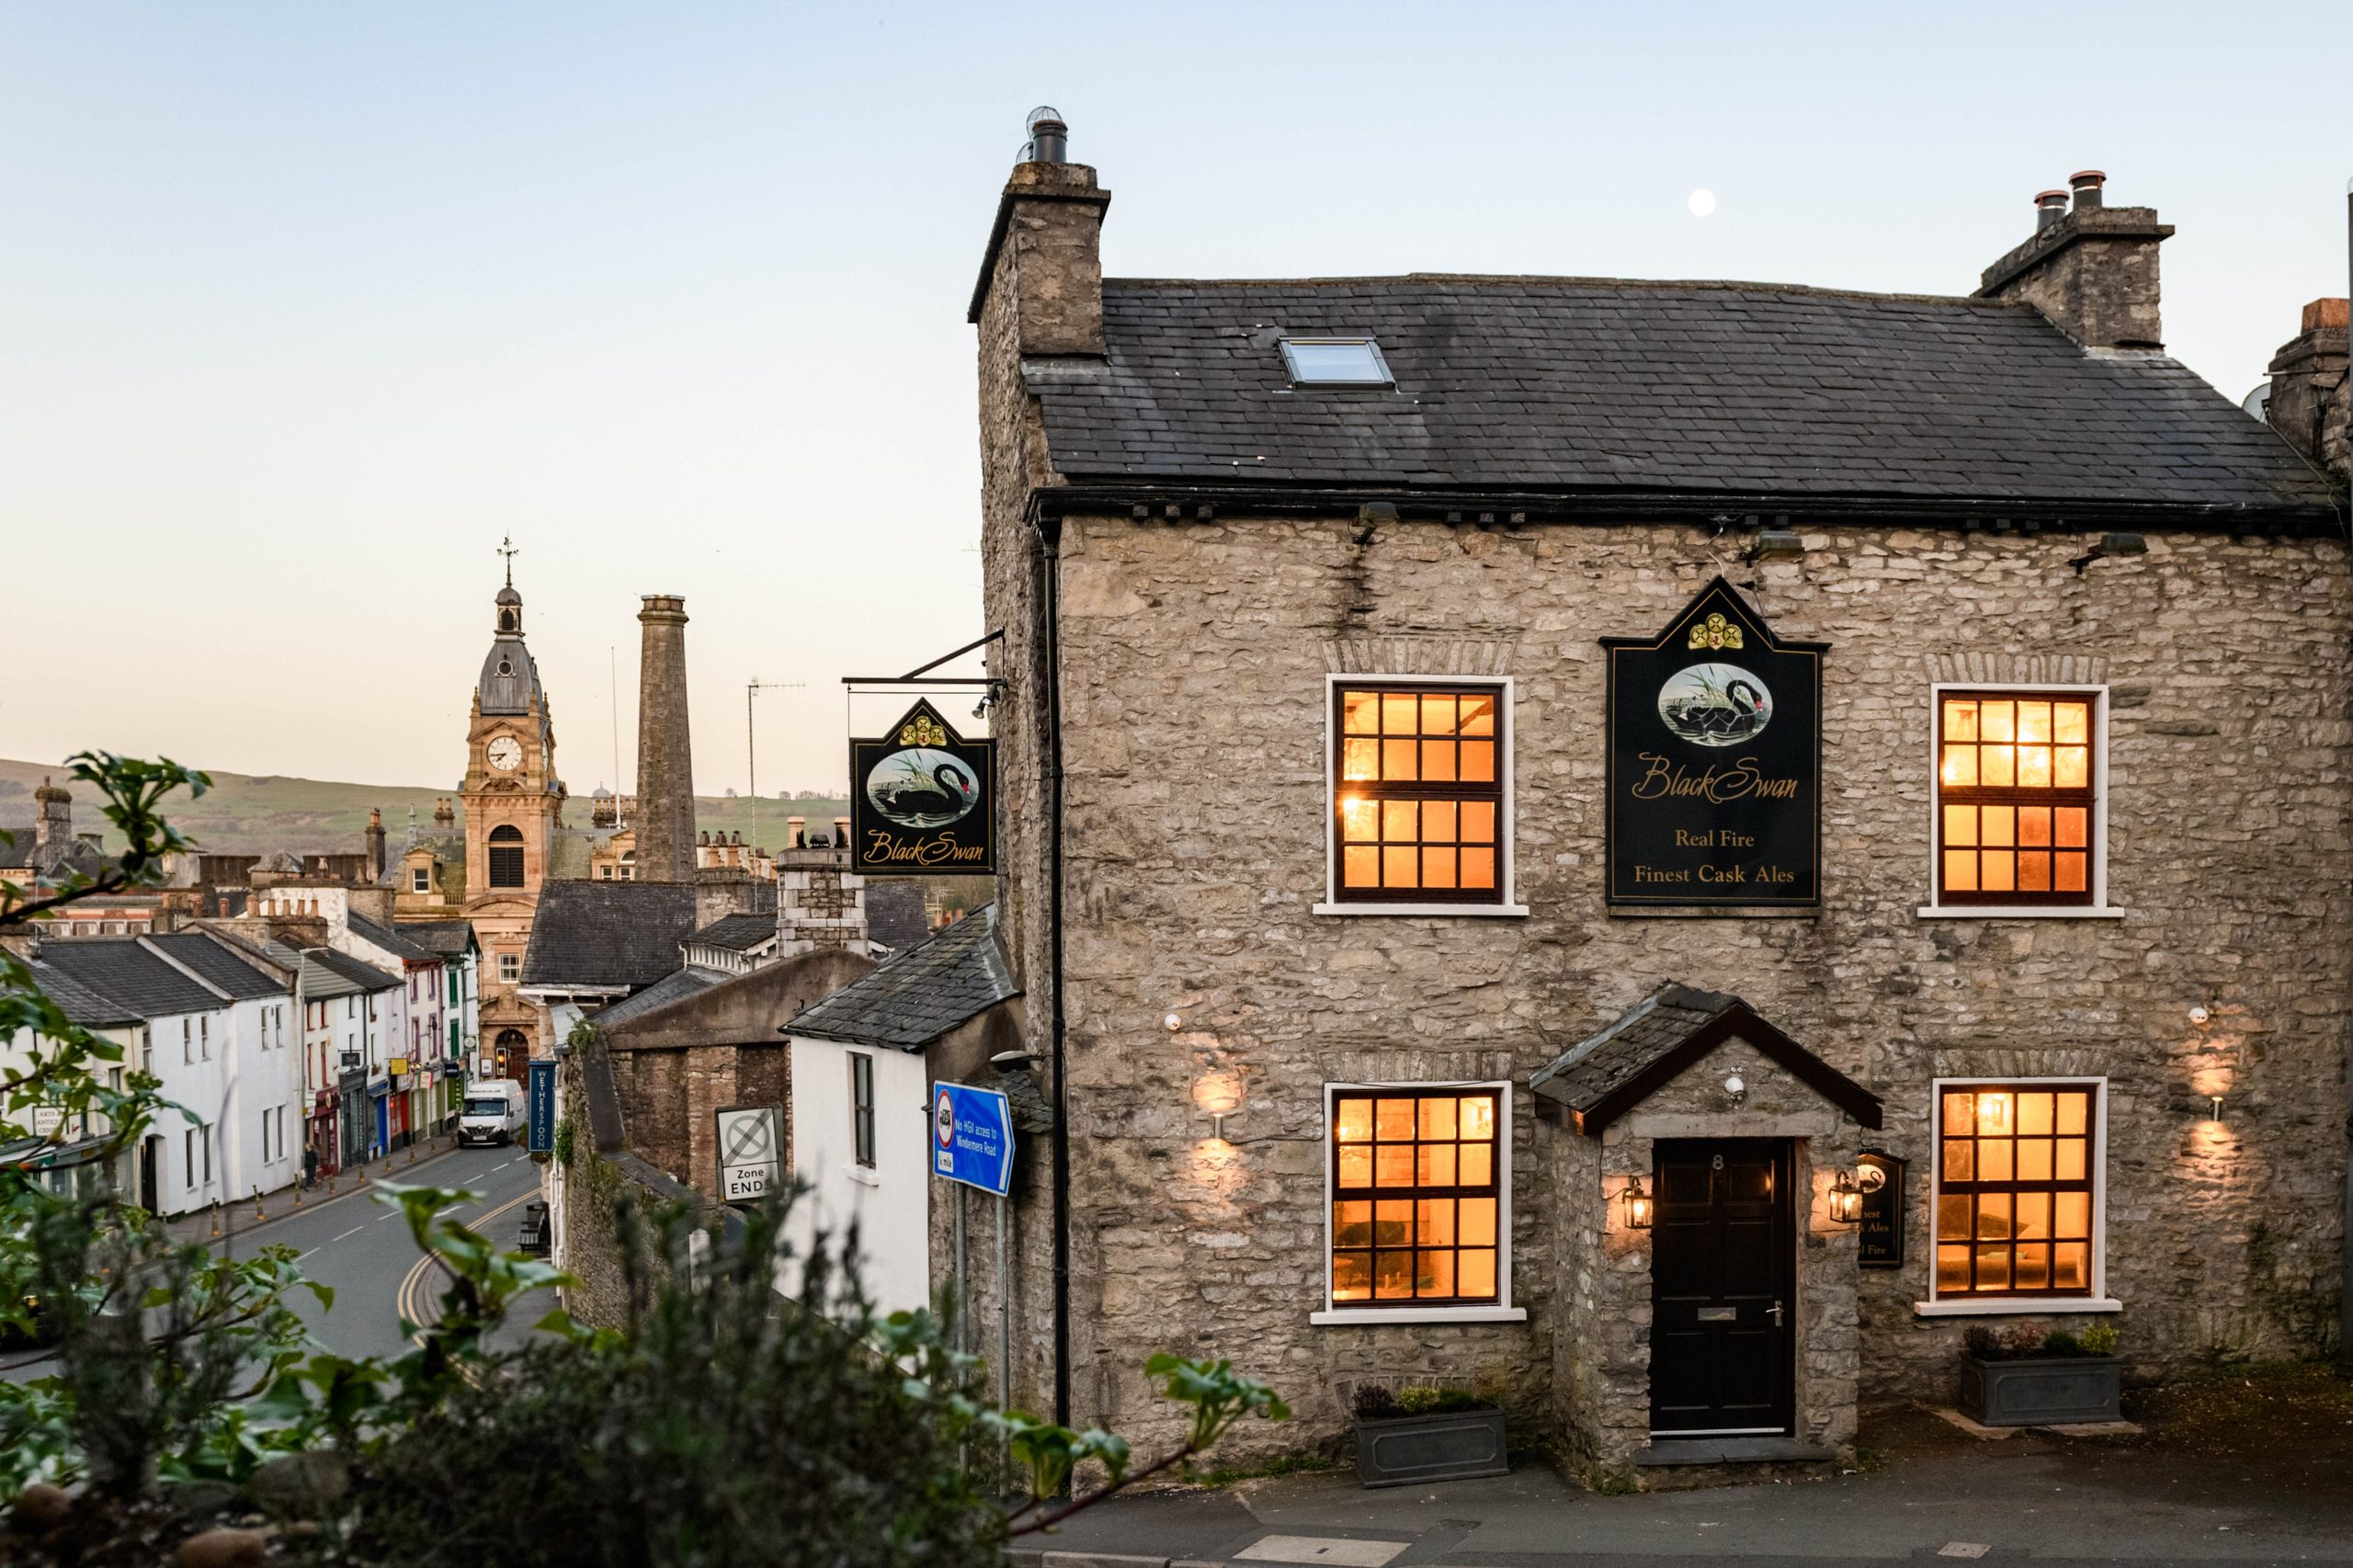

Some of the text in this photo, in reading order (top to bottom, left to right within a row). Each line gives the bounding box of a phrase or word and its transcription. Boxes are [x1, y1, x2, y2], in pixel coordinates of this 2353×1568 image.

[1632, 752, 1798, 804] Black Swan
[864, 829, 984, 865] Black Swan
[1676, 829, 1755, 846] Real Fire
[1633, 865, 1795, 883] Finest Cask Ales
[537, 1070, 547, 1148] WETHERSPOON
[955, 1119, 997, 1140] No HGV access to
[957, 1135, 996, 1157] Windermere Road
[1712, 1153, 1724, 1170] 8
[737, 1169, 764, 1179] Zone
